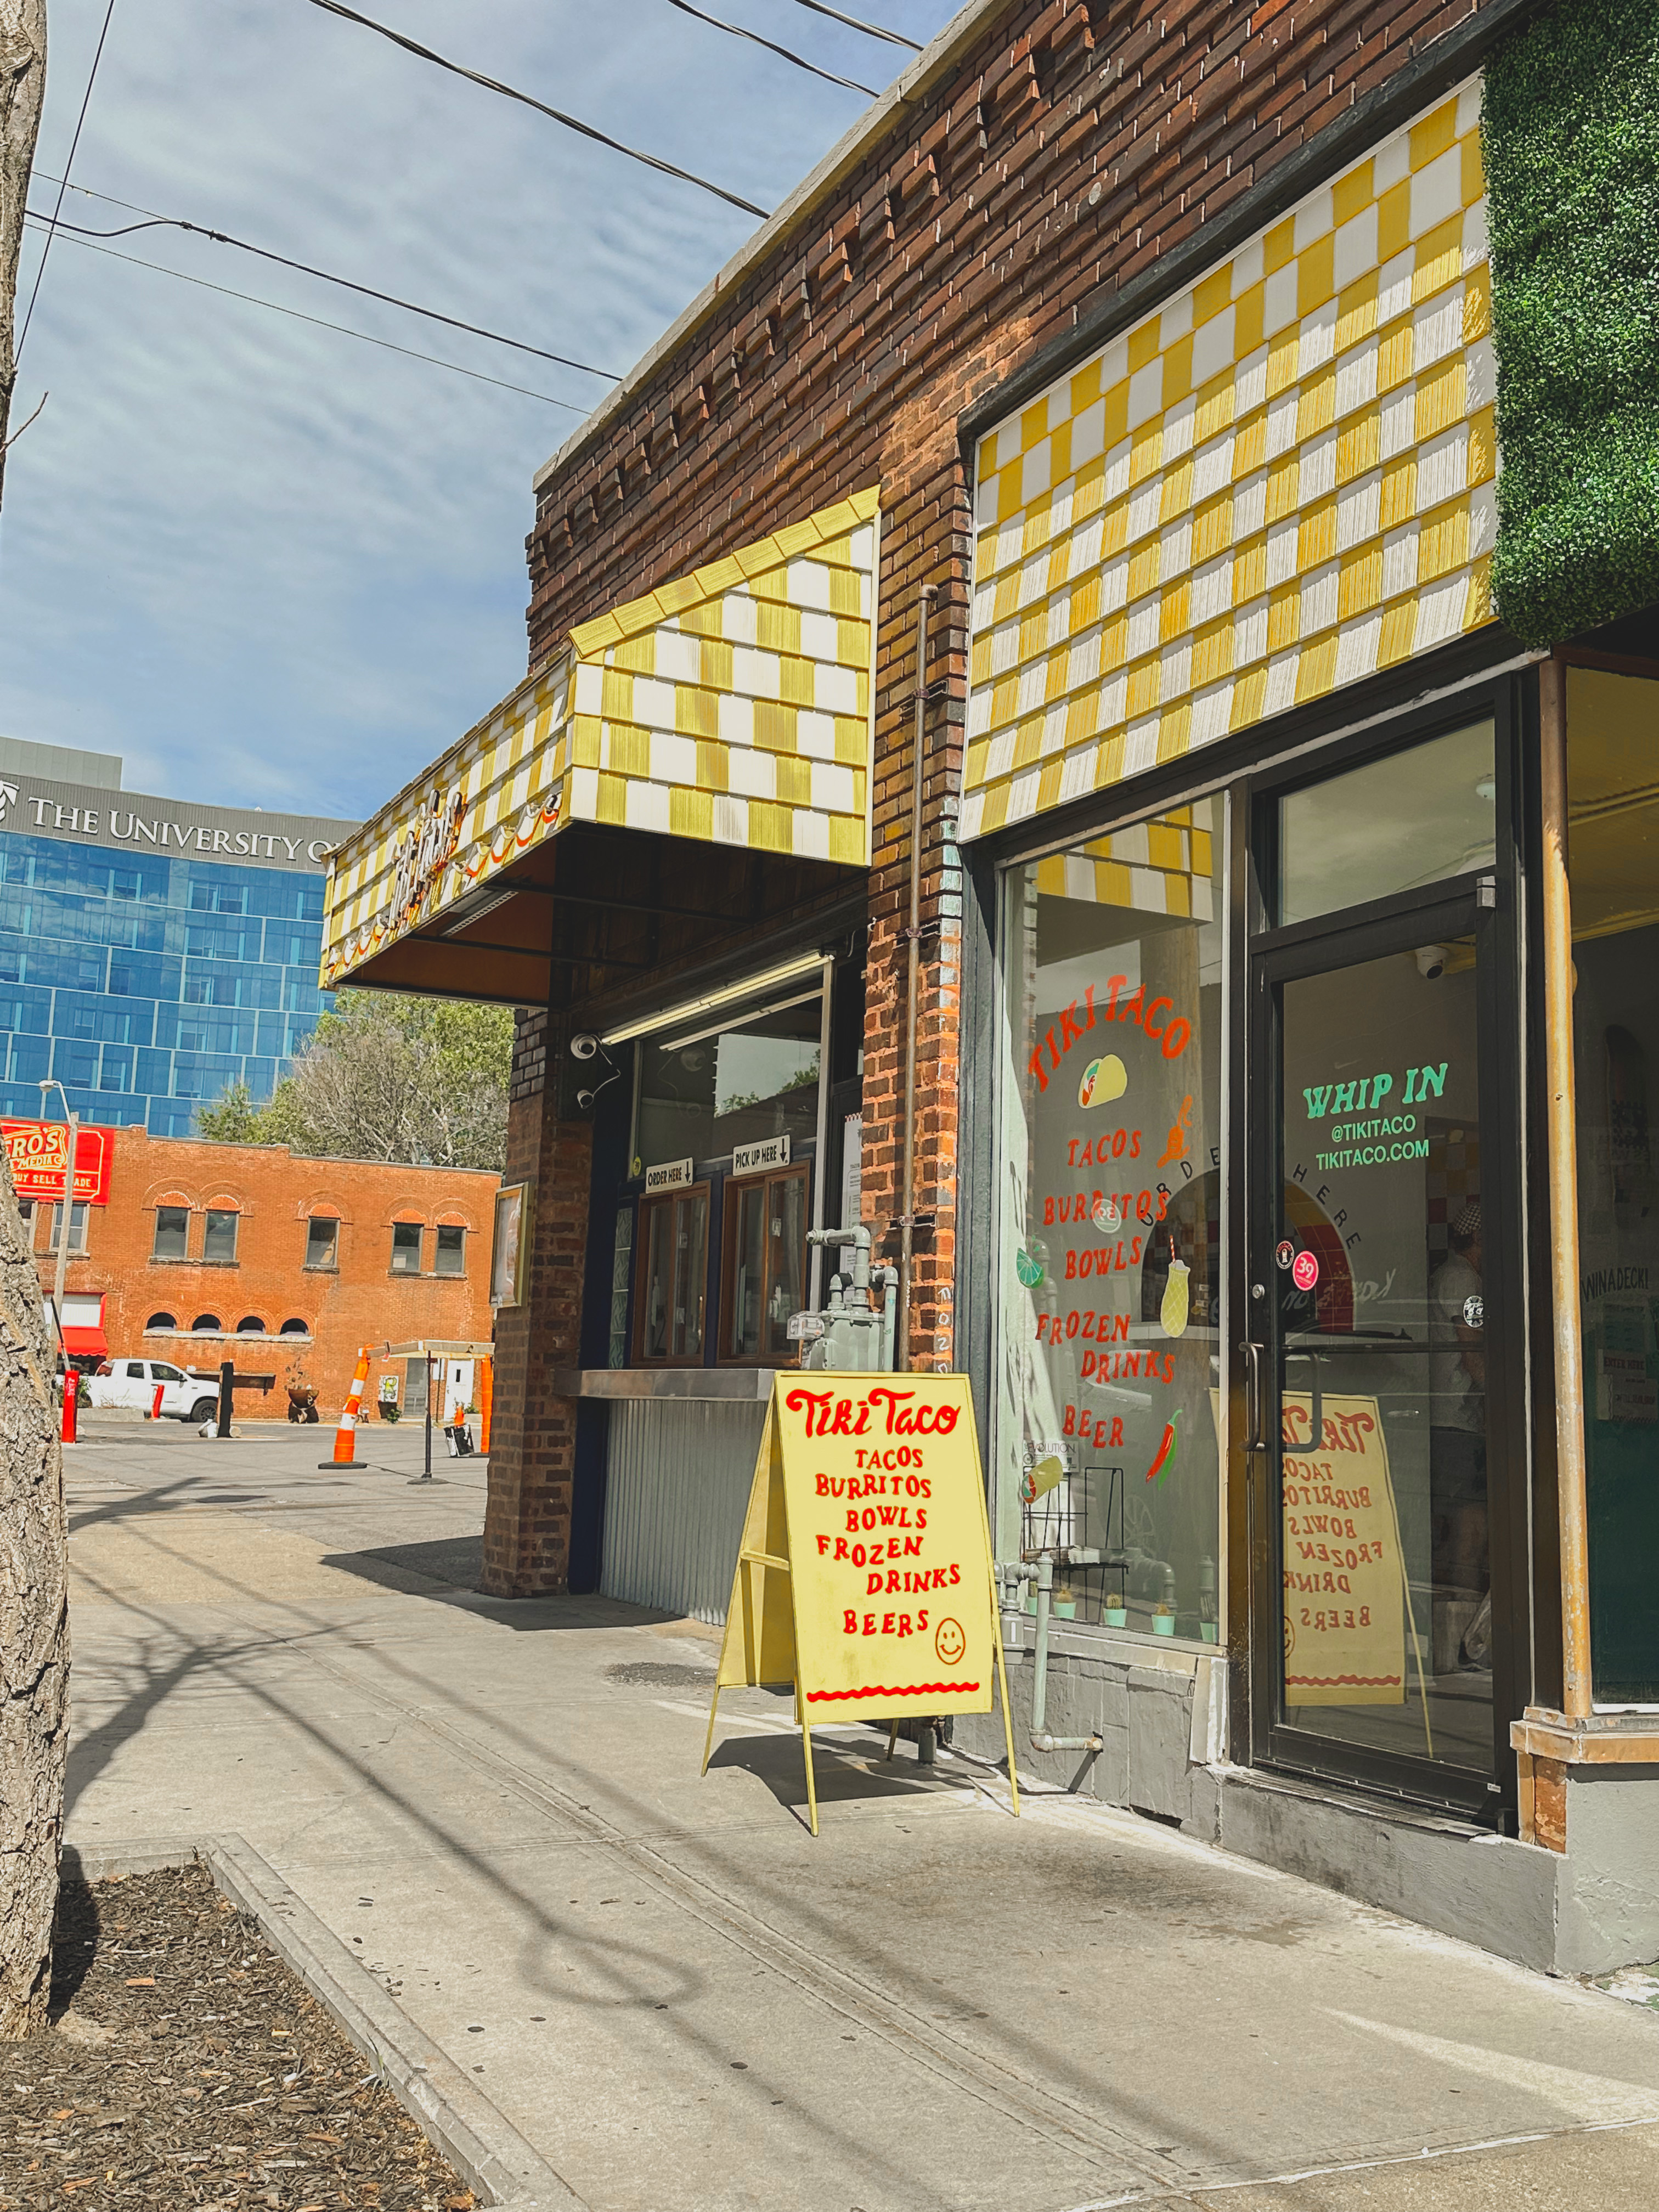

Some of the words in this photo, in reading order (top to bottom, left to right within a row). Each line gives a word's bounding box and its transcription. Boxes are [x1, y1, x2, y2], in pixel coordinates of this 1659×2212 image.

[29, 797, 99, 834] THE
[109, 810, 303, 861] UNIVERSITY
[308, 840, 341, 863] O
[1028, 984, 1096, 1092] TIKI
[1105, 974, 1190, 1059] TACO
[1304, 1074, 1393, 1119] WHIP
[1402, 1063, 1448, 1105] IN
[1331, 1114, 1416, 1143] @TIKITACO
[19, 1155, 53, 1169] MEDIA
[736, 1152, 750, 1169] PICK
[752, 1149, 760, 1165] UP
[762, 1145, 777, 1163] HERE
[1068, 1128, 1142, 1168] TACOS
[1316, 1139, 1429, 1170] TIKITACO.COM
[13, 1173, 29, 1182] BUY
[33, 1175, 57, 1185] SELL
[62, 1176, 91, 1187] TADE
[648, 1170, 667, 1187] ORDER
[668, 1167, 682, 1183] HERE
[1043, 1189, 1169, 1226] BURRITOS
[1065, 1236, 1142, 1279] BOWLS
[1297, 1256, 1314, 1279] 39
[1036, 1310, 1130, 1345] FROZEN
[1080, 1350, 1175, 1384] DRINKS
[786, 1389, 872, 1437] Tiki
[868, 1387, 961, 1436] Taco
[1063, 1405, 1124, 1449] BEER
[855, 1445, 923, 1471] TACOS
[815, 1473, 932, 1500] BURRITOS
[845, 1505, 927, 1532] BOWLS
[816, 1534, 923, 1568] FROZEN
[867, 1564, 961, 1595] DRINKS
[843, 1609, 929, 1638] BEERS
